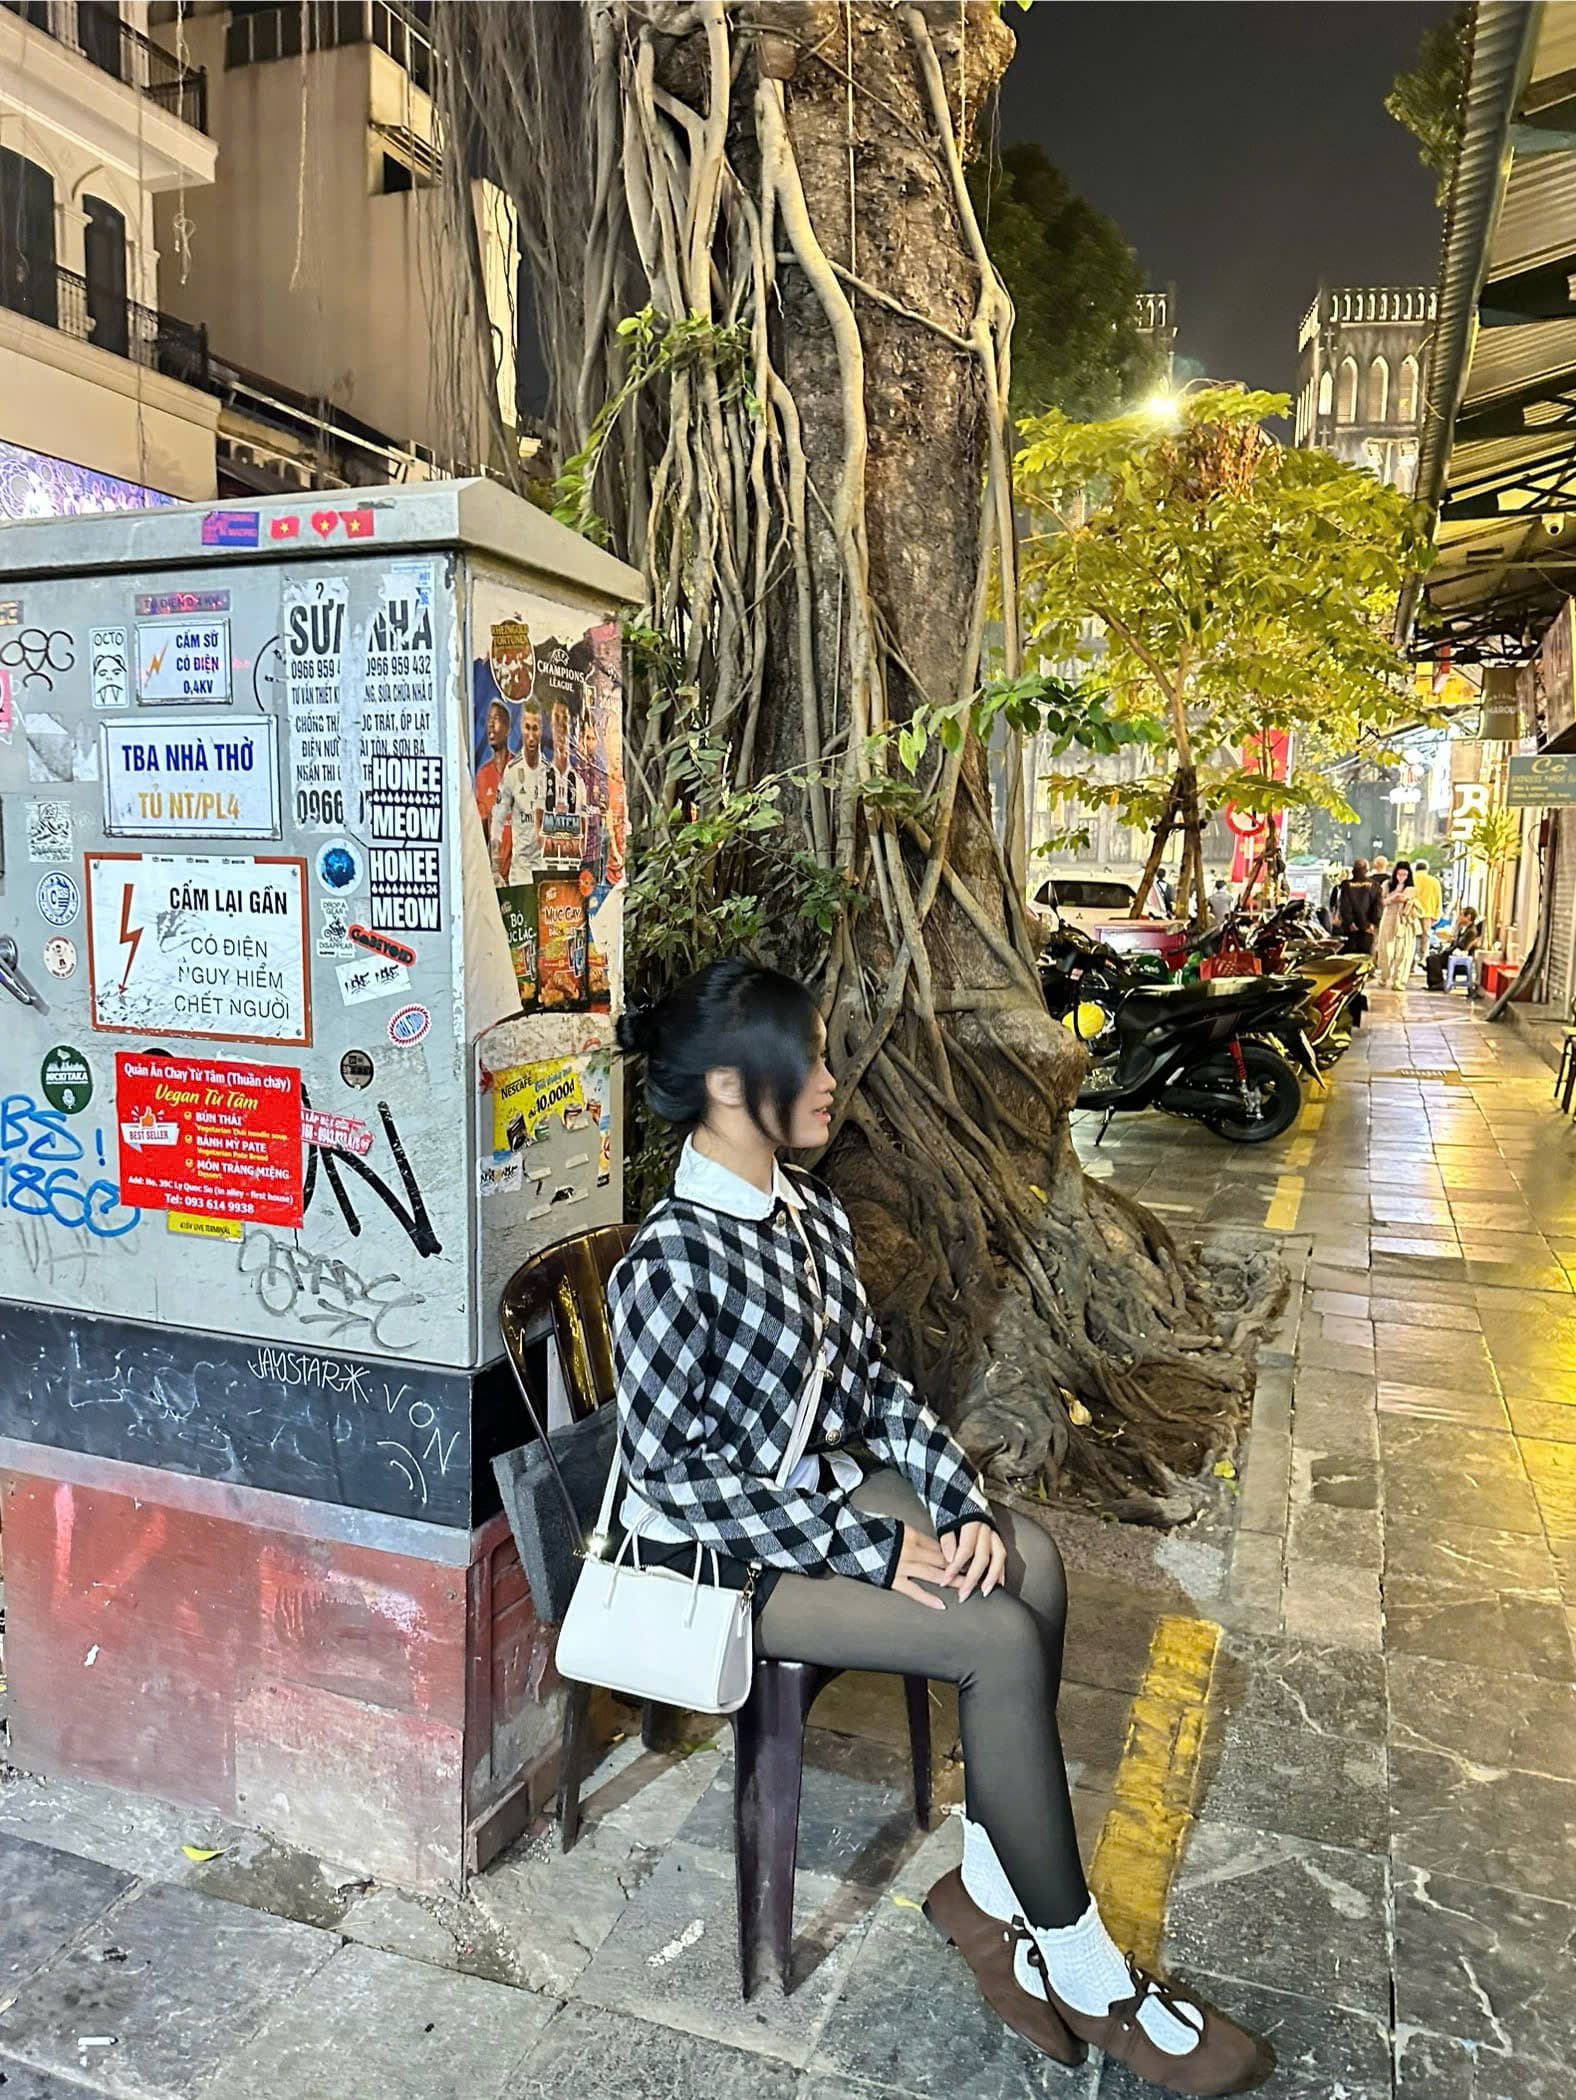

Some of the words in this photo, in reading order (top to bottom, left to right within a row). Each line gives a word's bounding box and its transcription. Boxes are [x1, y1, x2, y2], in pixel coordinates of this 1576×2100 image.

[94, 632, 124, 647] OCTO
[176, 629, 200, 648] CẤM
[176, 655, 190, 671] CÓ
[193, 654, 219, 674] ĐIỆN
[291, 658, 314, 679] 0966
[317, 658, 335, 678] 959
[391, 656, 410, 675] 959
[412, 655, 431, 674] 432
[537, 660, 585, 683] CHAMPIONS
[549, 678, 574, 692] LEAGUE
[295, 710, 325, 733] CHỐNG
[122, 744, 160, 771] TBA
[166, 738, 208, 771] NHÀ
[214, 736, 254, 771] THỜ
[322, 765, 336, 781] THI
[373, 757, 441, 792] HONEE
[138, 783, 162, 818] TỦ
[168, 791, 240, 819] NT/PL4
[373, 804, 440, 839] MEOW
[369, 850, 438, 882] HONEE
[170, 879, 209, 911] CẤM
[215, 889, 242, 917] LẠI
[250, 885, 288, 915] GẦN
[372, 897, 438, 928] MEOW
[191, 933, 218, 955] CÓ
[223, 936, 268, 961] ĐIỆN
[236, 962, 283, 989] HIỂM
[174, 990, 223, 1014] CHẾT
[230, 996, 289, 1020] NGƯỜI
[124, 1063, 148, 1077] Quán
[165, 1067, 188, 1082] Chay
[205, 1070, 224, 1083] Tâm
[264, 1077, 291, 1092] chay)
[155, 1084, 200, 1106] Vegan
[227, 1090, 258, 1110] Tâm
[129, 1130, 144, 1140] BEST
[146, 1129, 168, 1140] SELLER
[243, 1140, 266, 1152] PATE
[257, 1166, 289, 1180] MIỆNG
[128, 1176, 144, 1185] Add:
[174, 1182, 182, 1191] Ly
[226, 1189, 244, 1199] alley
[251, 1192, 265, 1200] first
[267, 1194, 293, 1204] house)
[165, 1194, 182, 1205] Tel:
[185, 1198, 203, 1207] 093
[207, 1200, 225, 1210] 614
[228, 1203, 254, 1213] 9938
